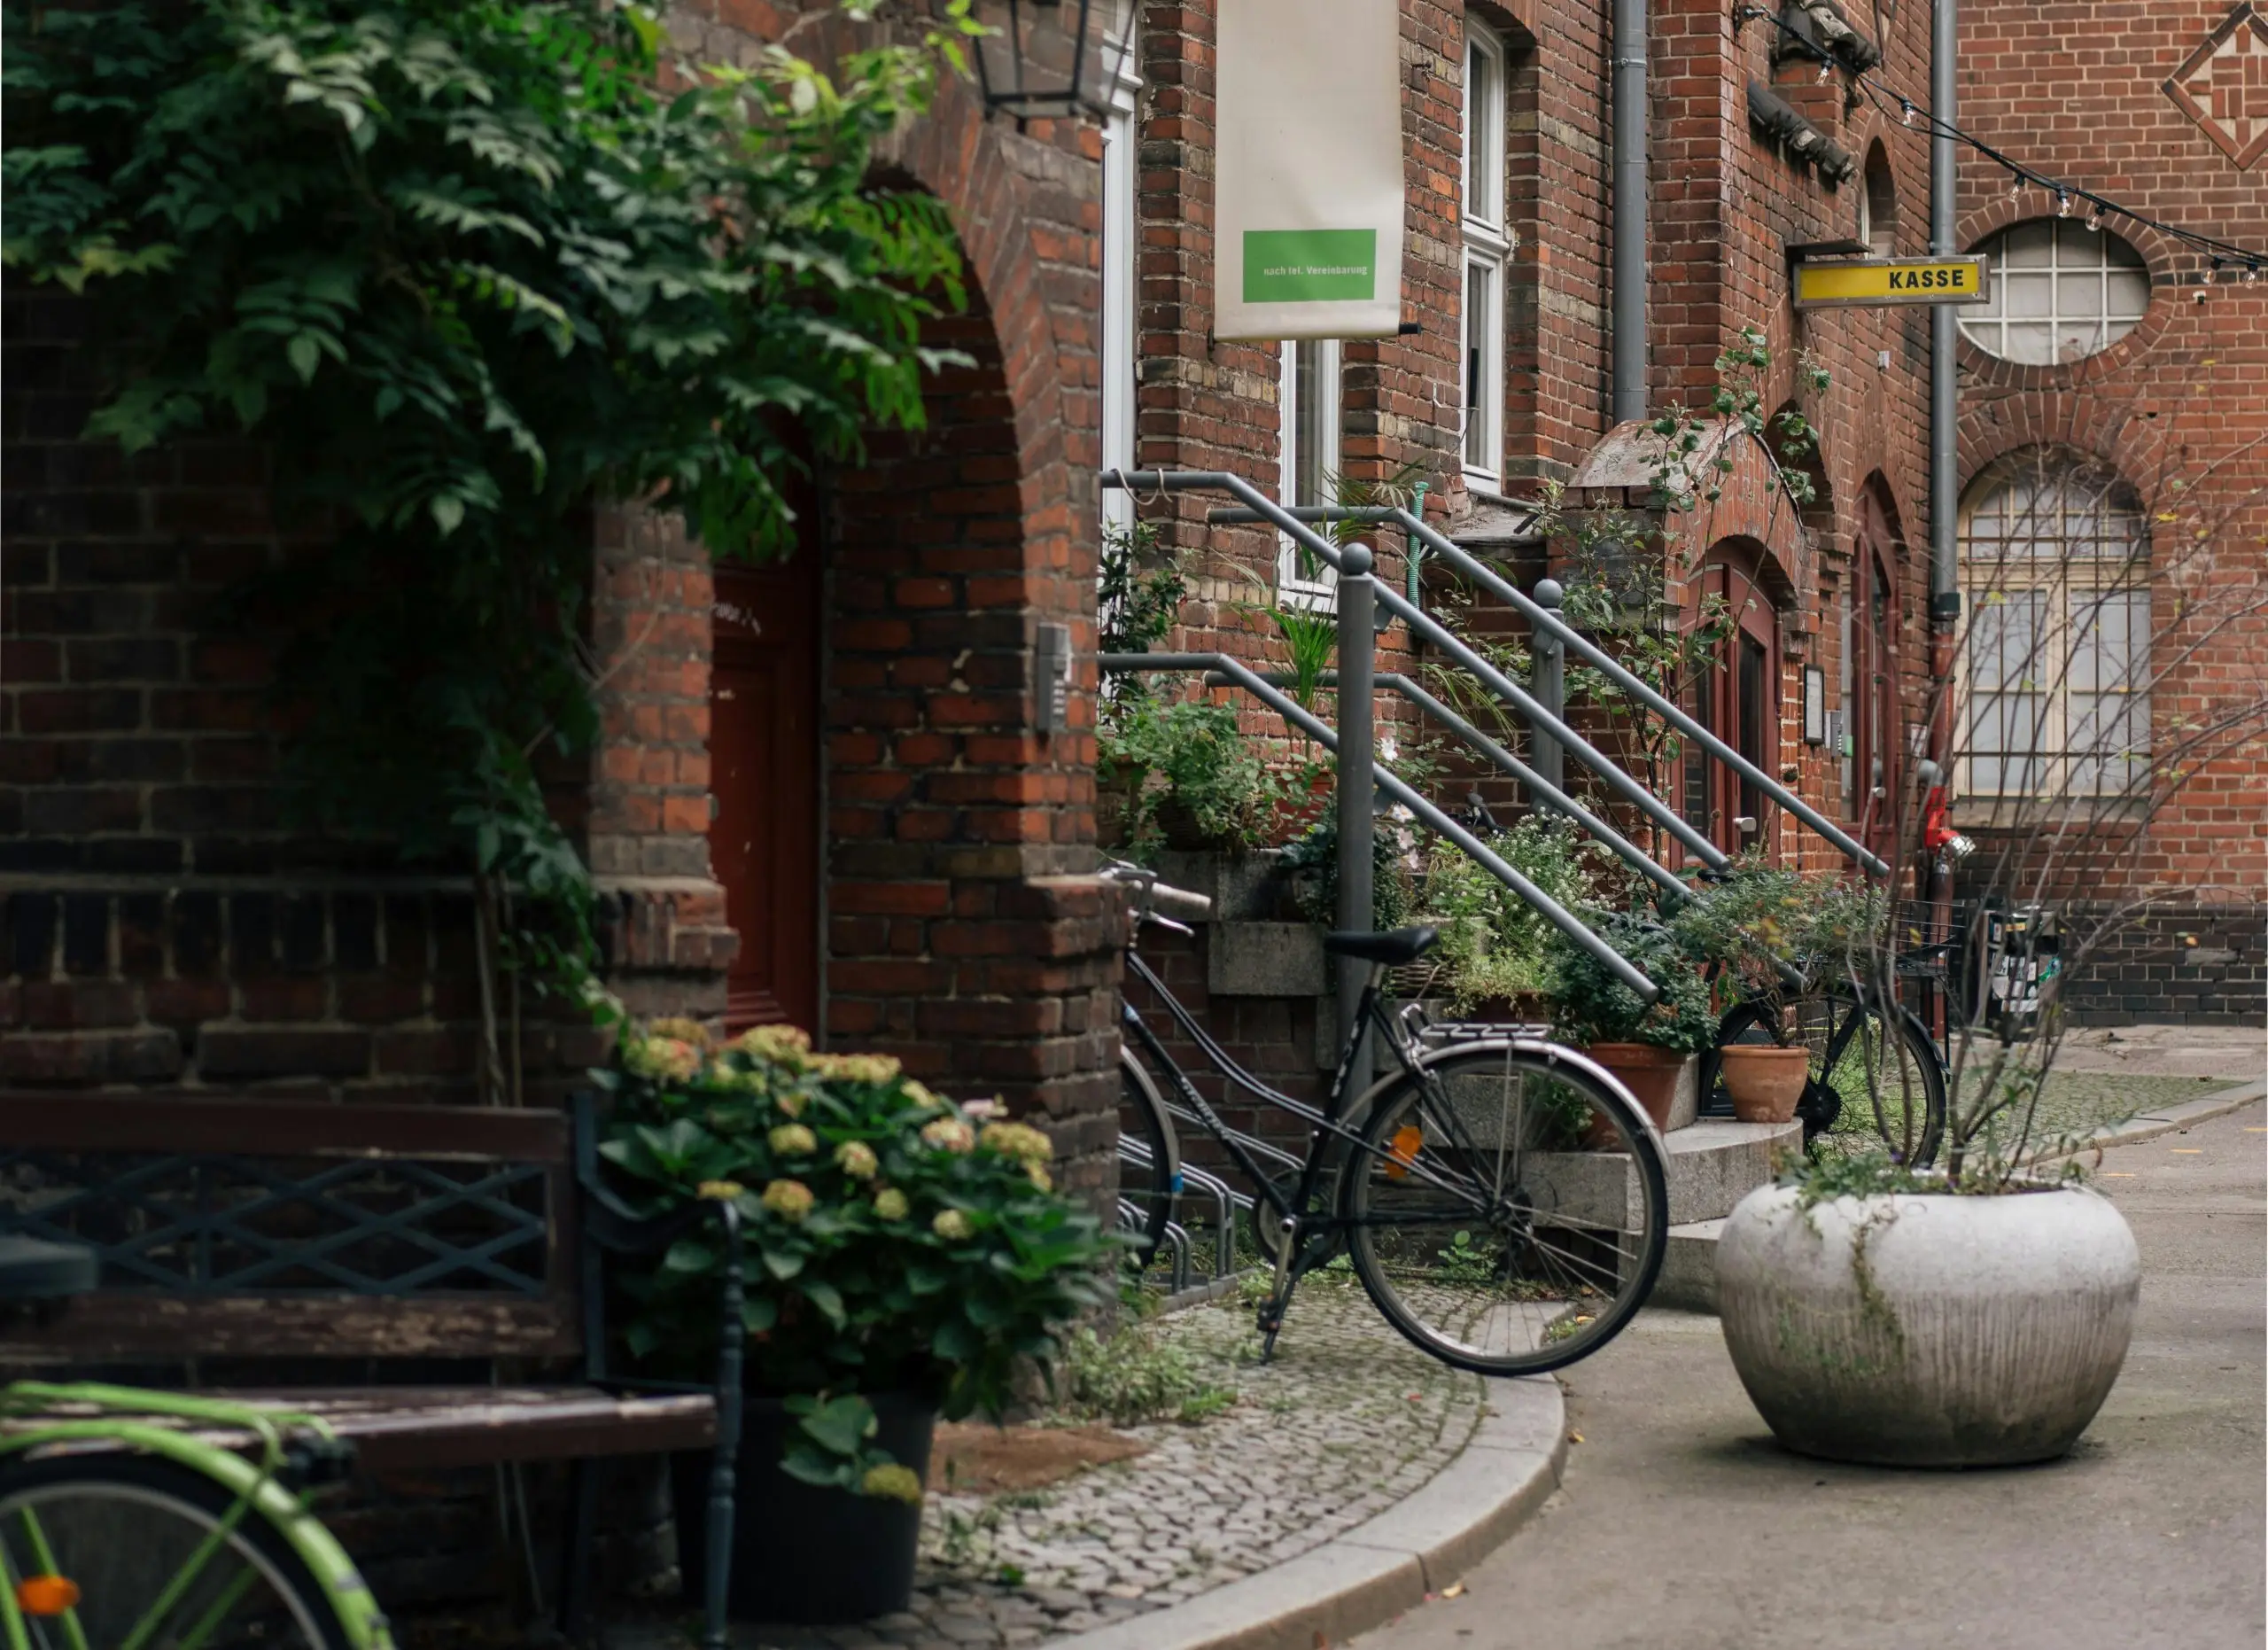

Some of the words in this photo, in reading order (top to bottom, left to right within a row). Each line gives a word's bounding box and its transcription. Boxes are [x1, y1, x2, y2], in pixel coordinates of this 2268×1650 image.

[1263, 266, 1286, 276] nach
[1288, 265, 1304, 276] tel.
[1307, 265, 1368, 276] Vereinbarung
[1889, 269, 1963, 289] KASSE
